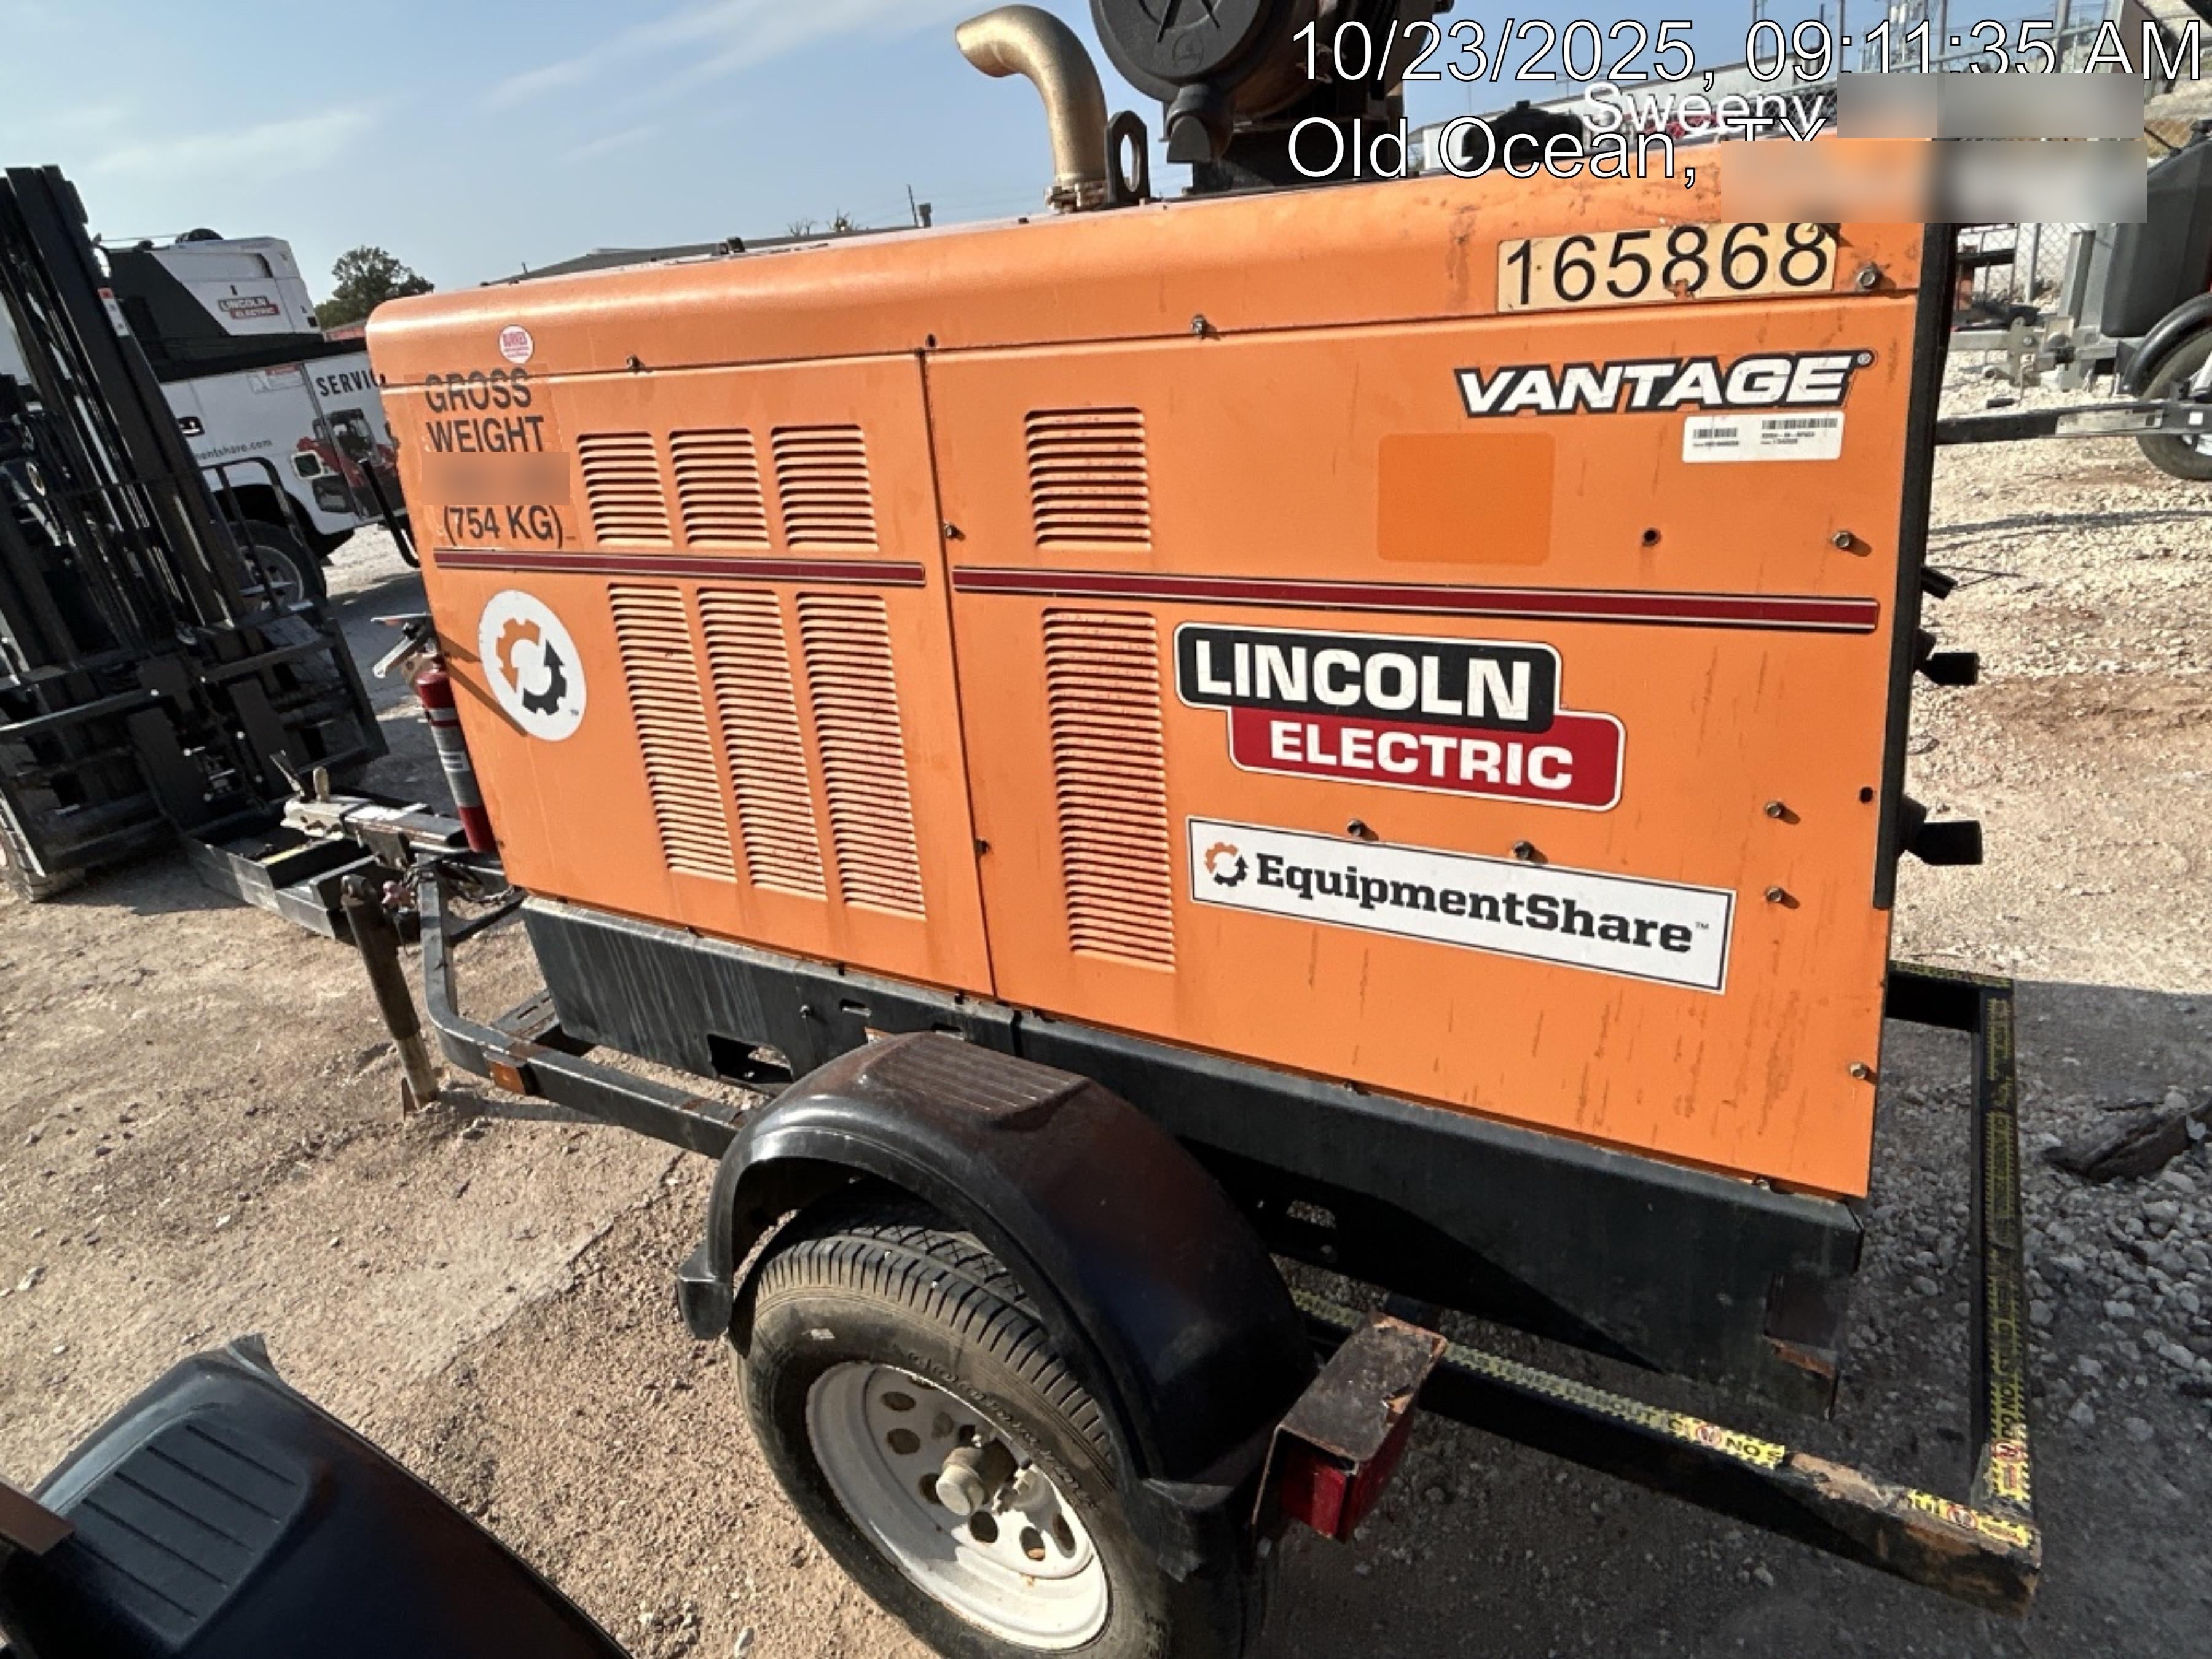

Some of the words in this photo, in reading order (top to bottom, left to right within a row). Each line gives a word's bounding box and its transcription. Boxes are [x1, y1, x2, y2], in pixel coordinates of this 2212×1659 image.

[1507, 223, 1827, 305] 165868
[425, 367, 532, 413] GROSS
[1459, 355, 1853, 414] VANTAGE
[425, 415, 544, 452] WEIGHT
[443, 505, 500, 546] (754
[505, 505, 563, 549] KG)
[1194, 639, 1531, 723] LINCOLN
[1269, 721, 1574, 790] ELECTRIC
[1255, 852, 1692, 954] EquipmentShare
